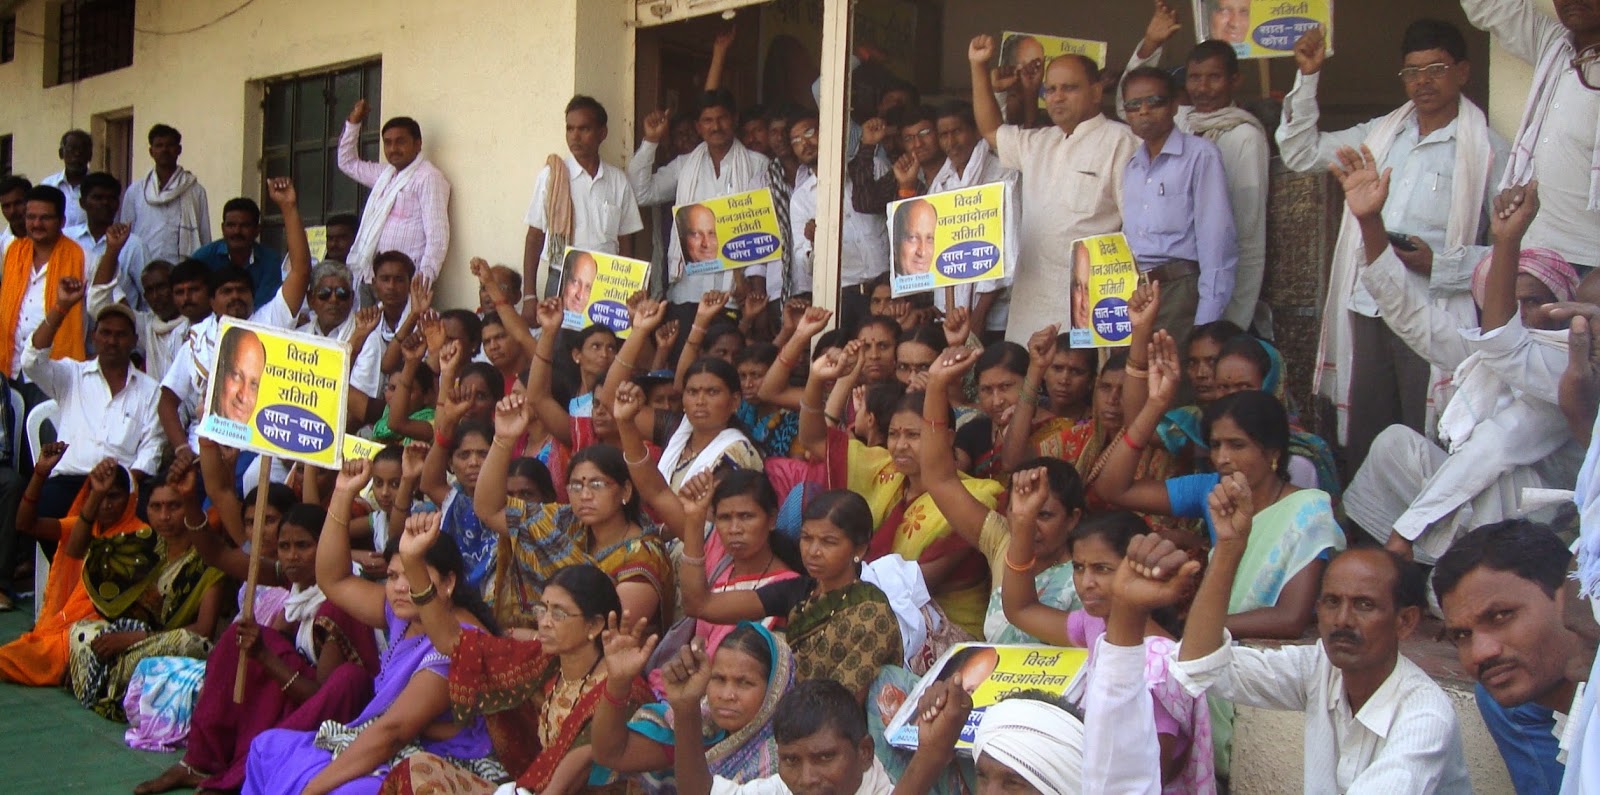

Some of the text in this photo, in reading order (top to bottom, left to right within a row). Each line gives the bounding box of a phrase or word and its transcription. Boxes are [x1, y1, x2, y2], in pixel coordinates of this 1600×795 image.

[728, 194, 752, 209] विदर्भ
[954, 191, 982, 208] विदर्भ
[938, 207, 998, 227] जनआंदोलन
[731, 219, 762, 234] समिती
[951, 224, 986, 240] समिती
[726, 235, 772, 250] सात-बारा
[1098, 238, 1118, 256] विदर्भ
[729, 244, 774, 260] कोरा करा
[942, 245, 994, 262] सात-बारा
[943, 259, 993, 275] कोरा करा
[1098, 277, 1125, 295] समिती
[1094, 306, 1128, 319] सात-बार
[1096, 320, 1132, 334] कोरा करा
[287, 343, 320, 366] विदर्भ
[265, 363, 338, 392] जनआंदोलन
[278, 385, 320, 408] समिती
[264, 408, 326, 435] सात-बारा
[263, 424, 324, 450] कोरा करा
[1022, 651, 1061, 668] विदर्भ
[990, 670, 1069, 687] जनआंदोलन
